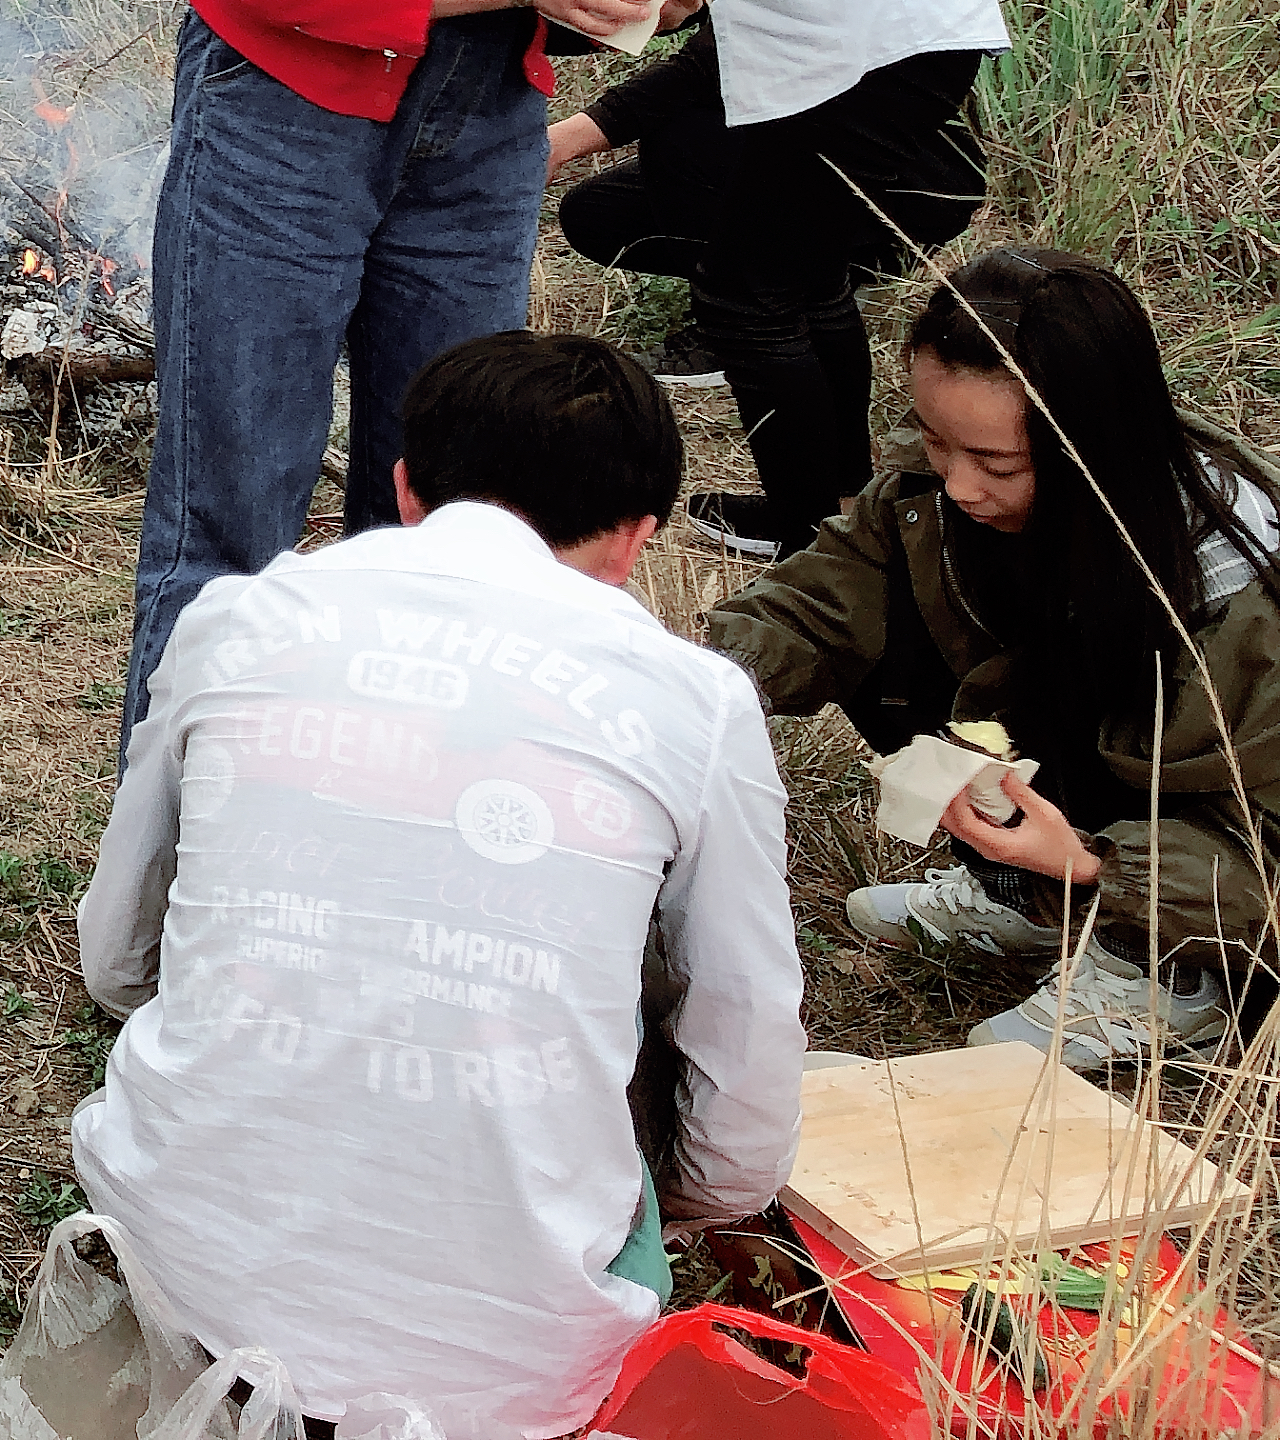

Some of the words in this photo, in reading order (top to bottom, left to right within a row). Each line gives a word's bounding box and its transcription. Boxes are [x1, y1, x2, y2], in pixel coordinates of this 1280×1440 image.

[377, 608, 656, 756] WHEELS
[237, 706, 440, 783] LEGEND
[211, 885, 340, 939] RACING
